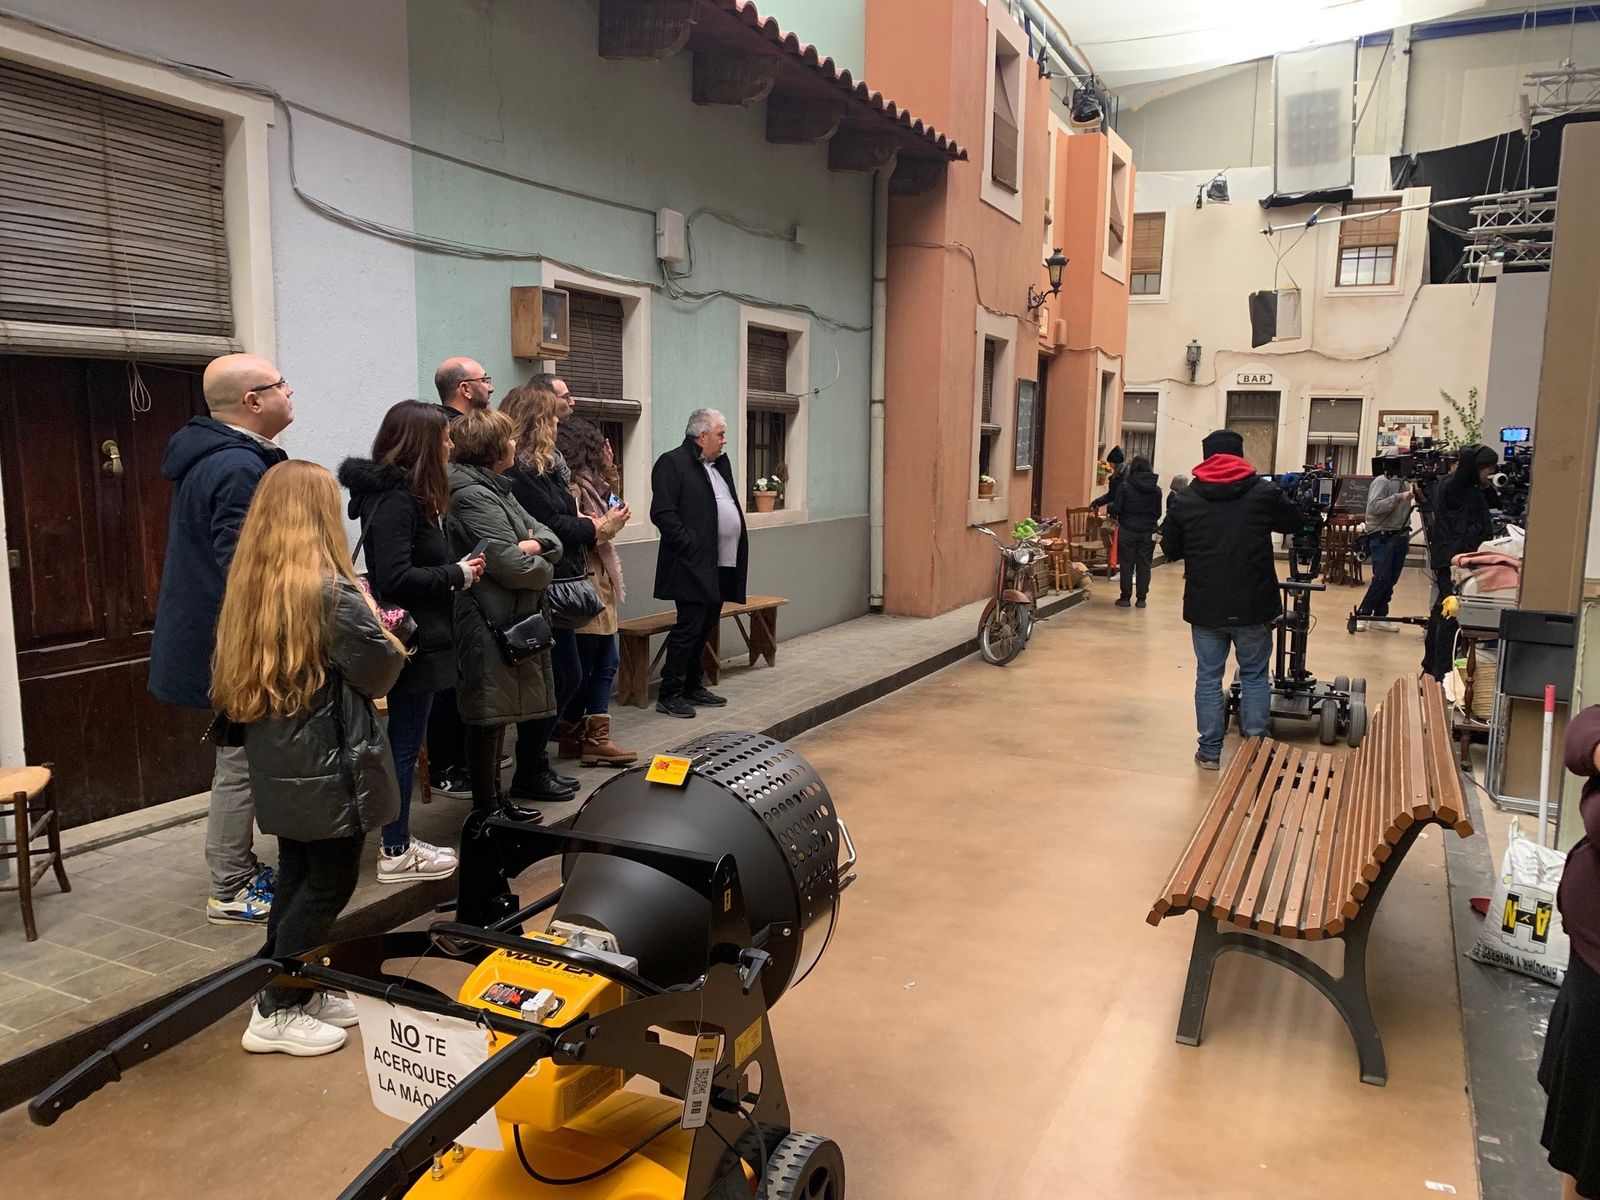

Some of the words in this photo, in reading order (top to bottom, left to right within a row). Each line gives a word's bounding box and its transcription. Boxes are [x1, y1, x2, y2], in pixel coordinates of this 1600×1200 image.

[1243, 375, 1266, 383] BAR
[1503, 899, 1519, 929] N
[1536, 907, 1551, 936] A
[390, 1019, 420, 1049] NO
[425, 1034, 446, 1057] TE
[373, 1046, 457, 1090] ACERQUES
[378, 1073, 396, 1096] LA
[399, 1084, 438, 1110] MÁQ
